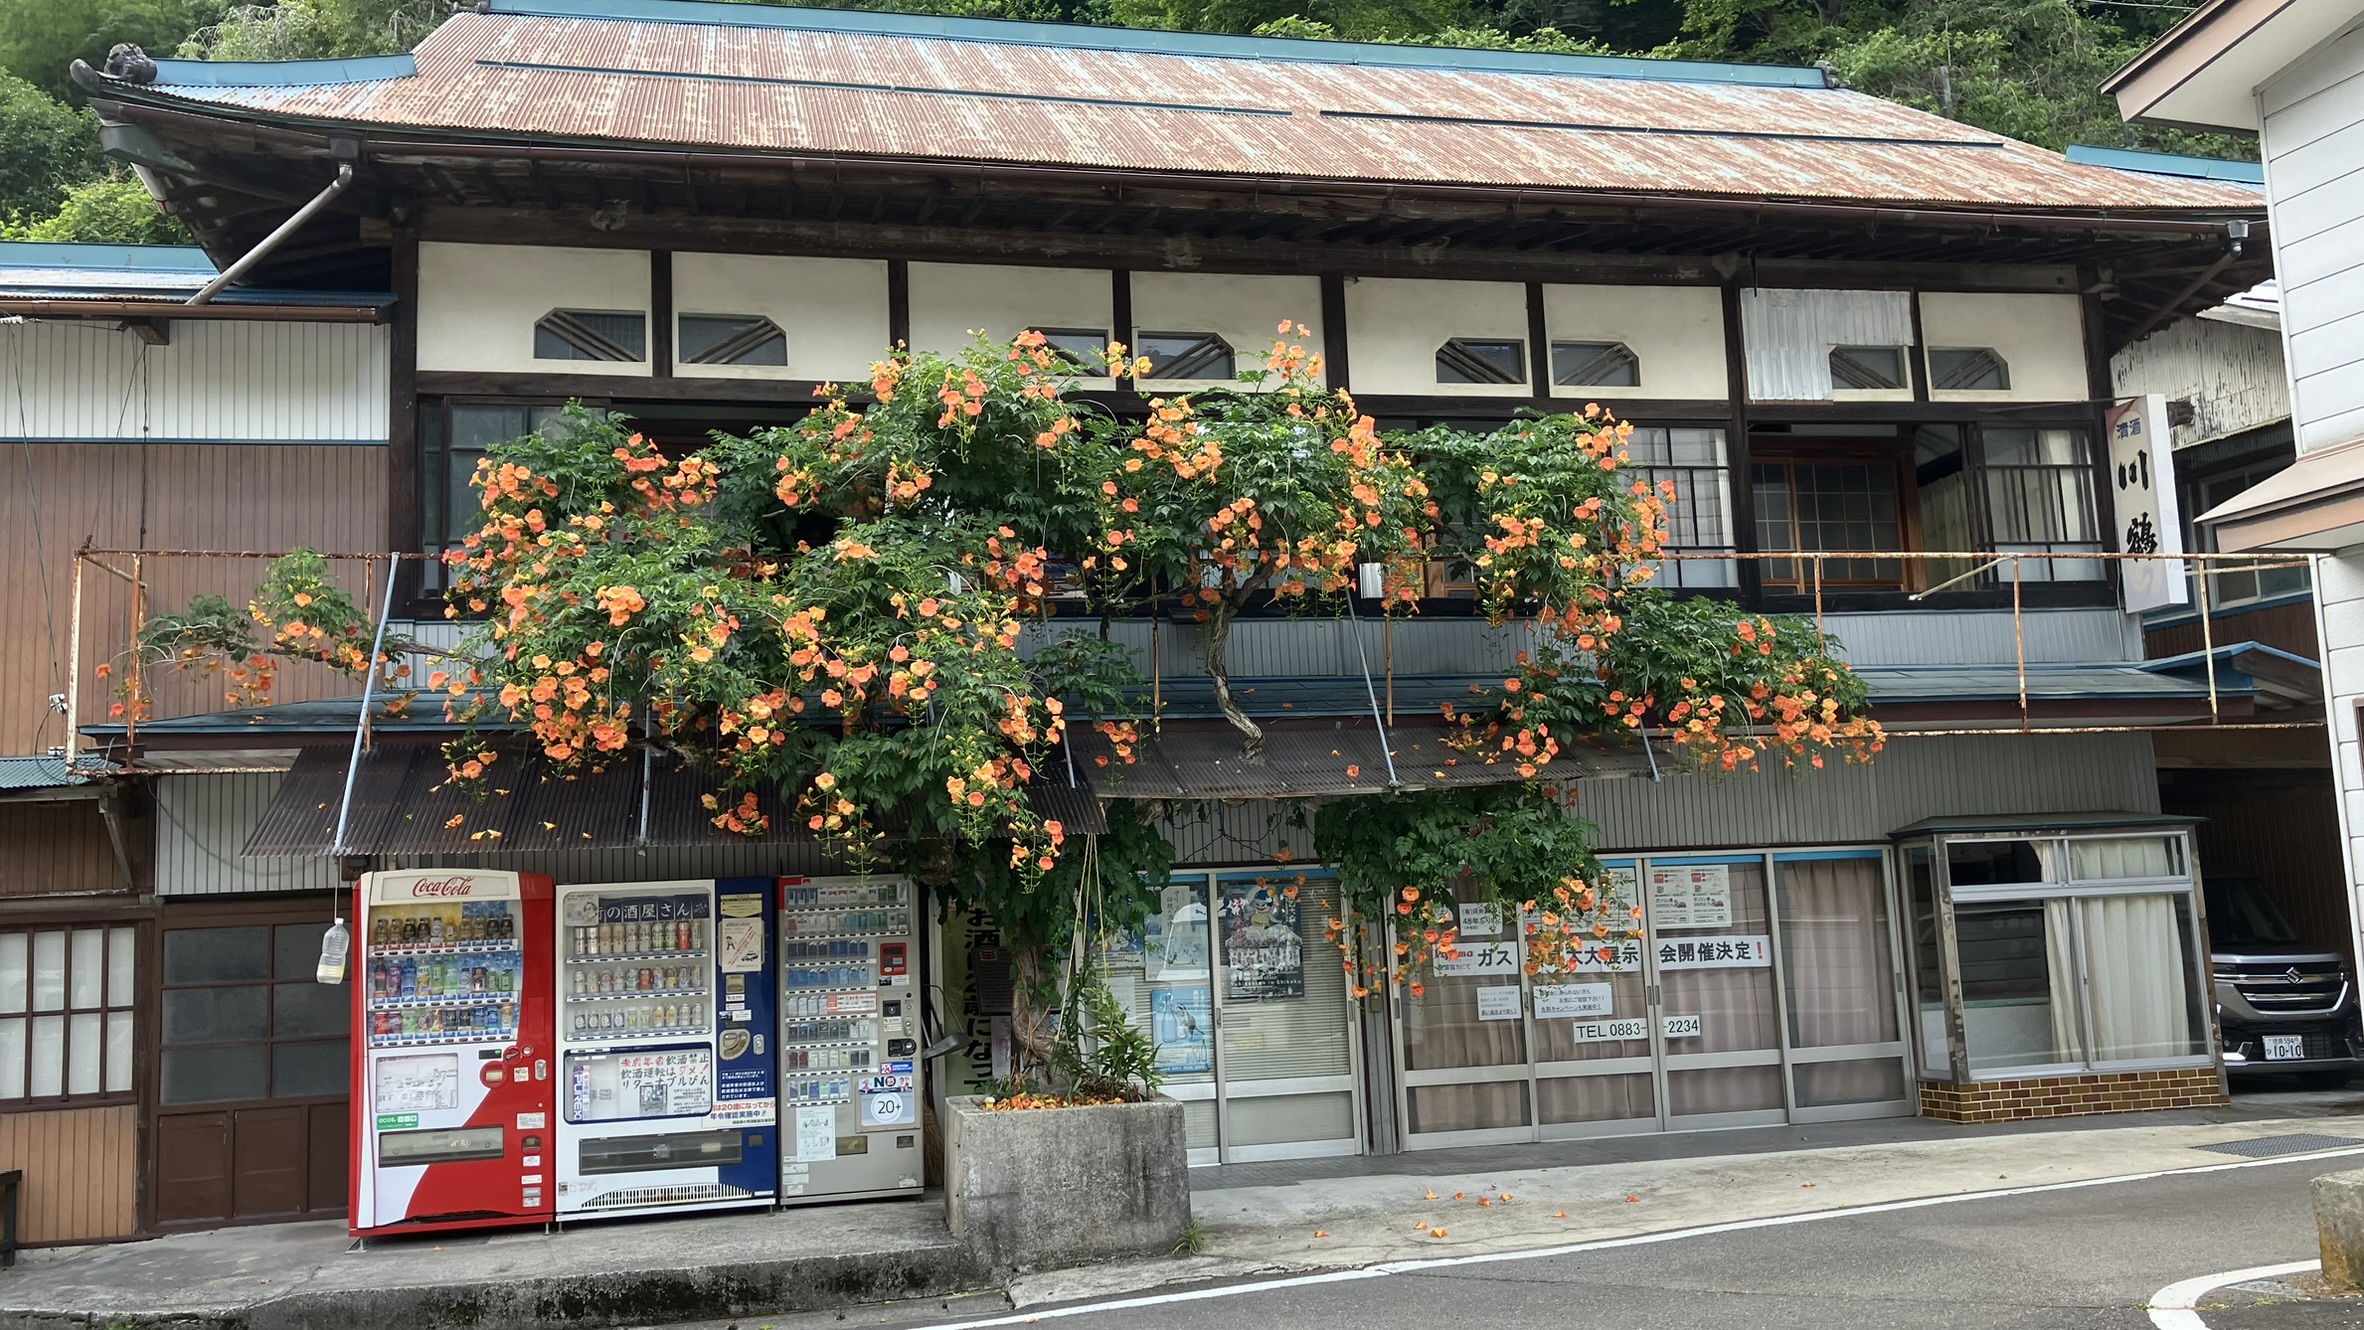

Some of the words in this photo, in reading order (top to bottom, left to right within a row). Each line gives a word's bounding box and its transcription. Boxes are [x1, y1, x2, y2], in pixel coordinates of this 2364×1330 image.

[2116, 417, 2142, 440] 清酒
[2118, 449, 2159, 563] 川鶴
[412, 876, 474, 898] Coca-Cola
[1478, 948, 1513, 967] ガス
[1659, 940, 1763, 964] 会開催決定!
[1576, 1025, 1606, 1038] TEL
[620, 1053, 709, 1068] 未成年者飲酒禁止
[2274, 1045, 2302, 1058] 10-10
[877, 1100, 901, 1114] 20+
